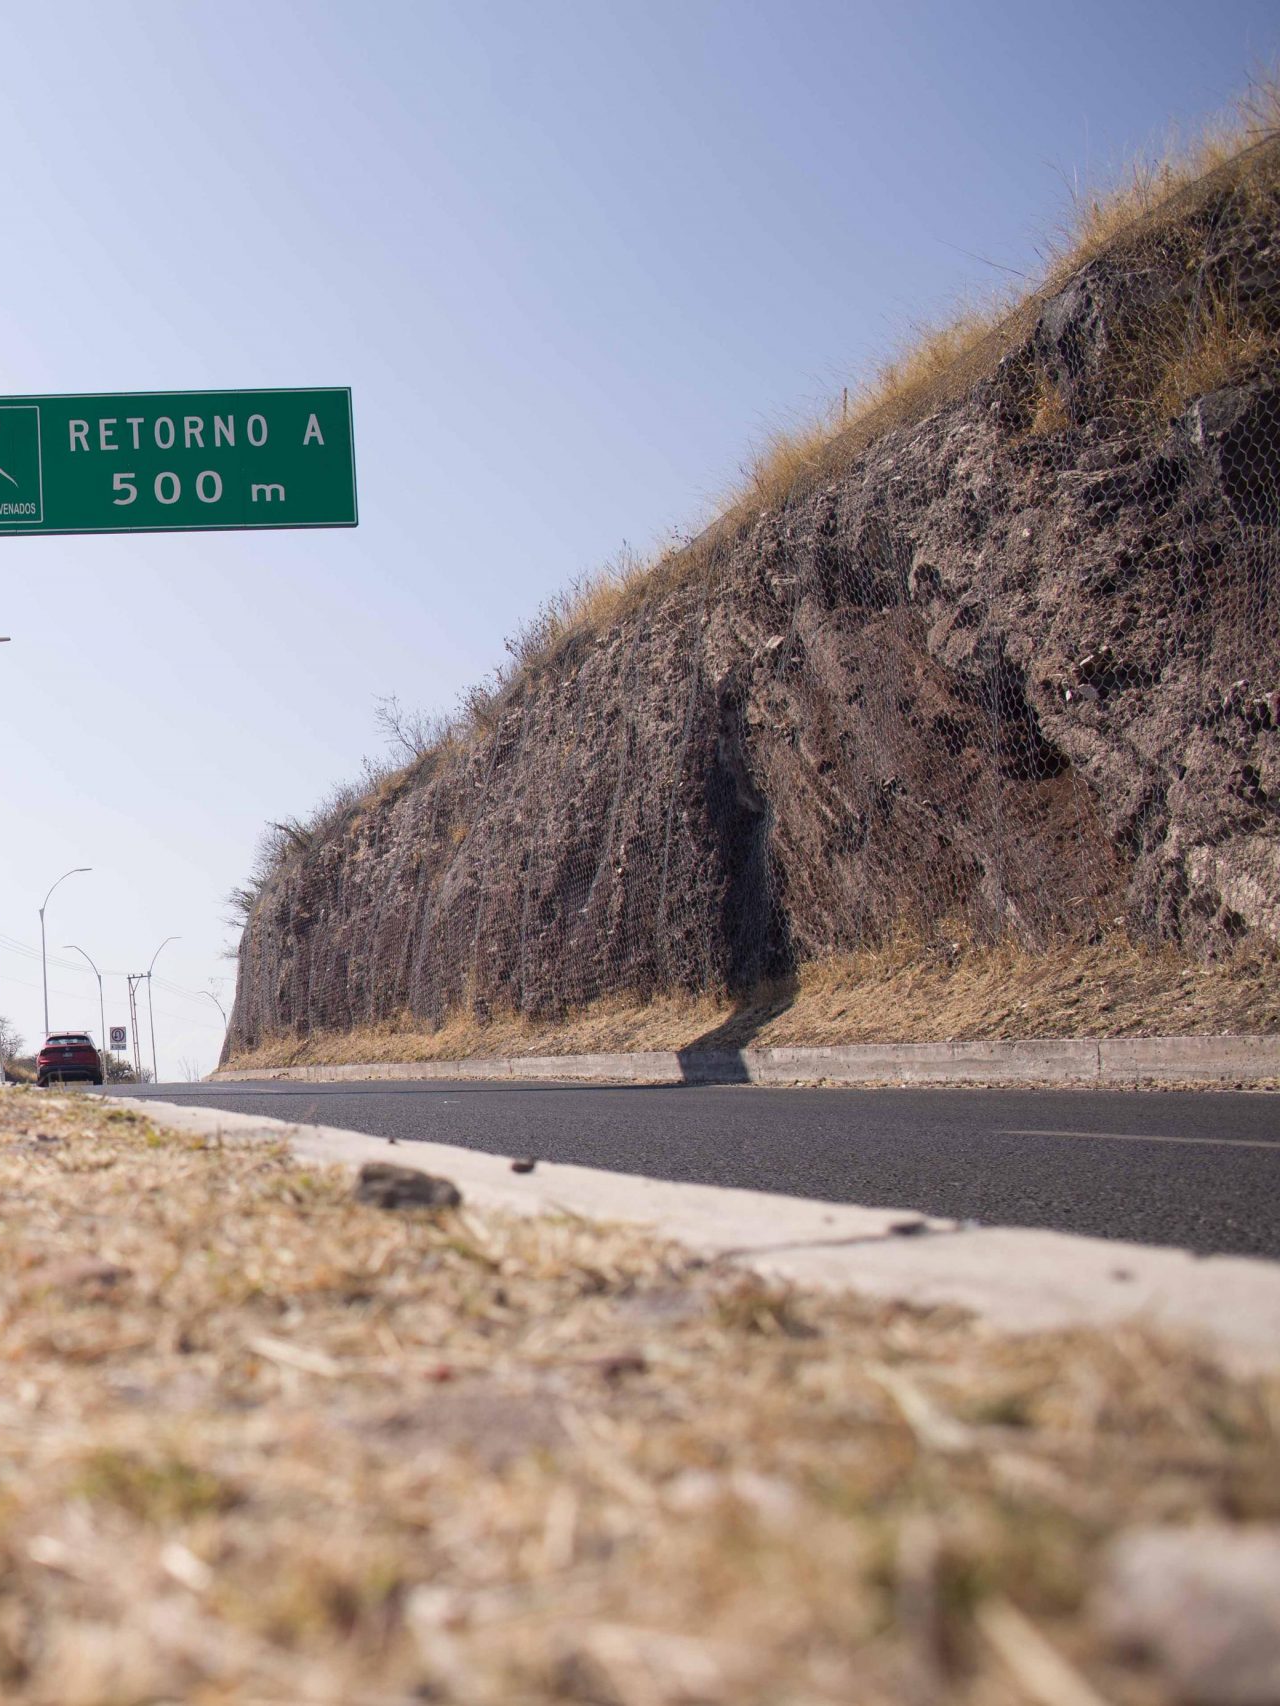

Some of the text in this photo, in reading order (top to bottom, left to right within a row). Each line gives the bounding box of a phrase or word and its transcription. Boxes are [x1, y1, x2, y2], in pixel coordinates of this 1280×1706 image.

[69, 413, 325, 452] RETORNO A
[112, 470, 286, 506] 500 m
